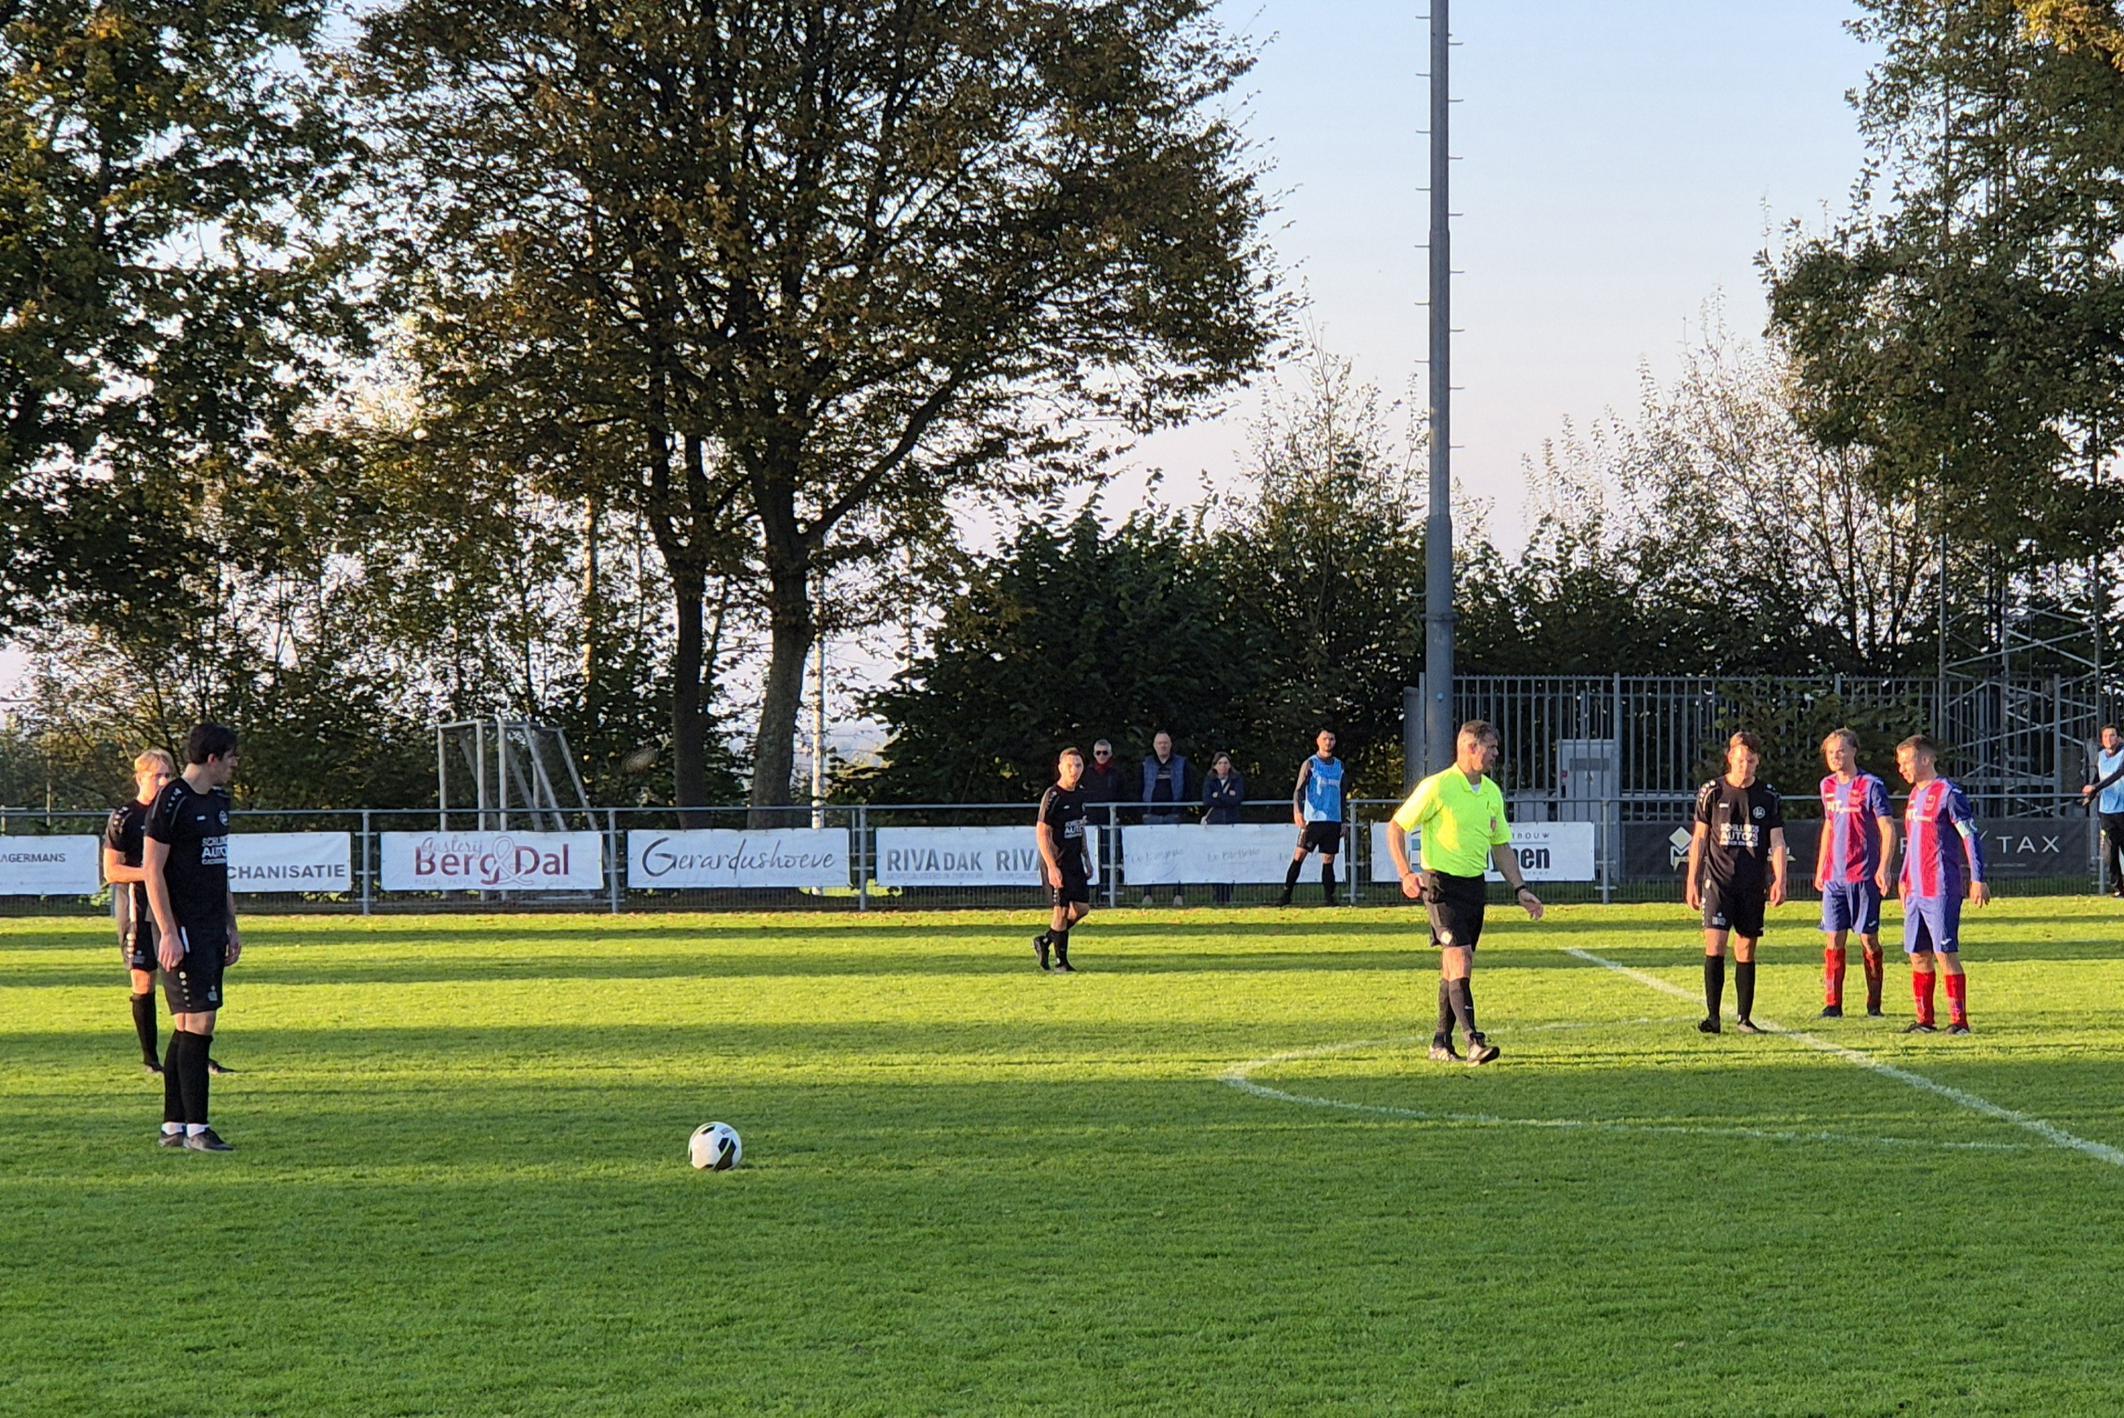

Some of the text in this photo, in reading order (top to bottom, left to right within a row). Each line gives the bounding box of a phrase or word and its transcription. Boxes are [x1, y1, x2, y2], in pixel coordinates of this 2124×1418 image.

[415, 847, 500, 885] Berg
[515, 843, 569, 876] Dal
[642, 836, 836, 878] Gerardushoeve
[1996, 835, 2061, 853] TAX
